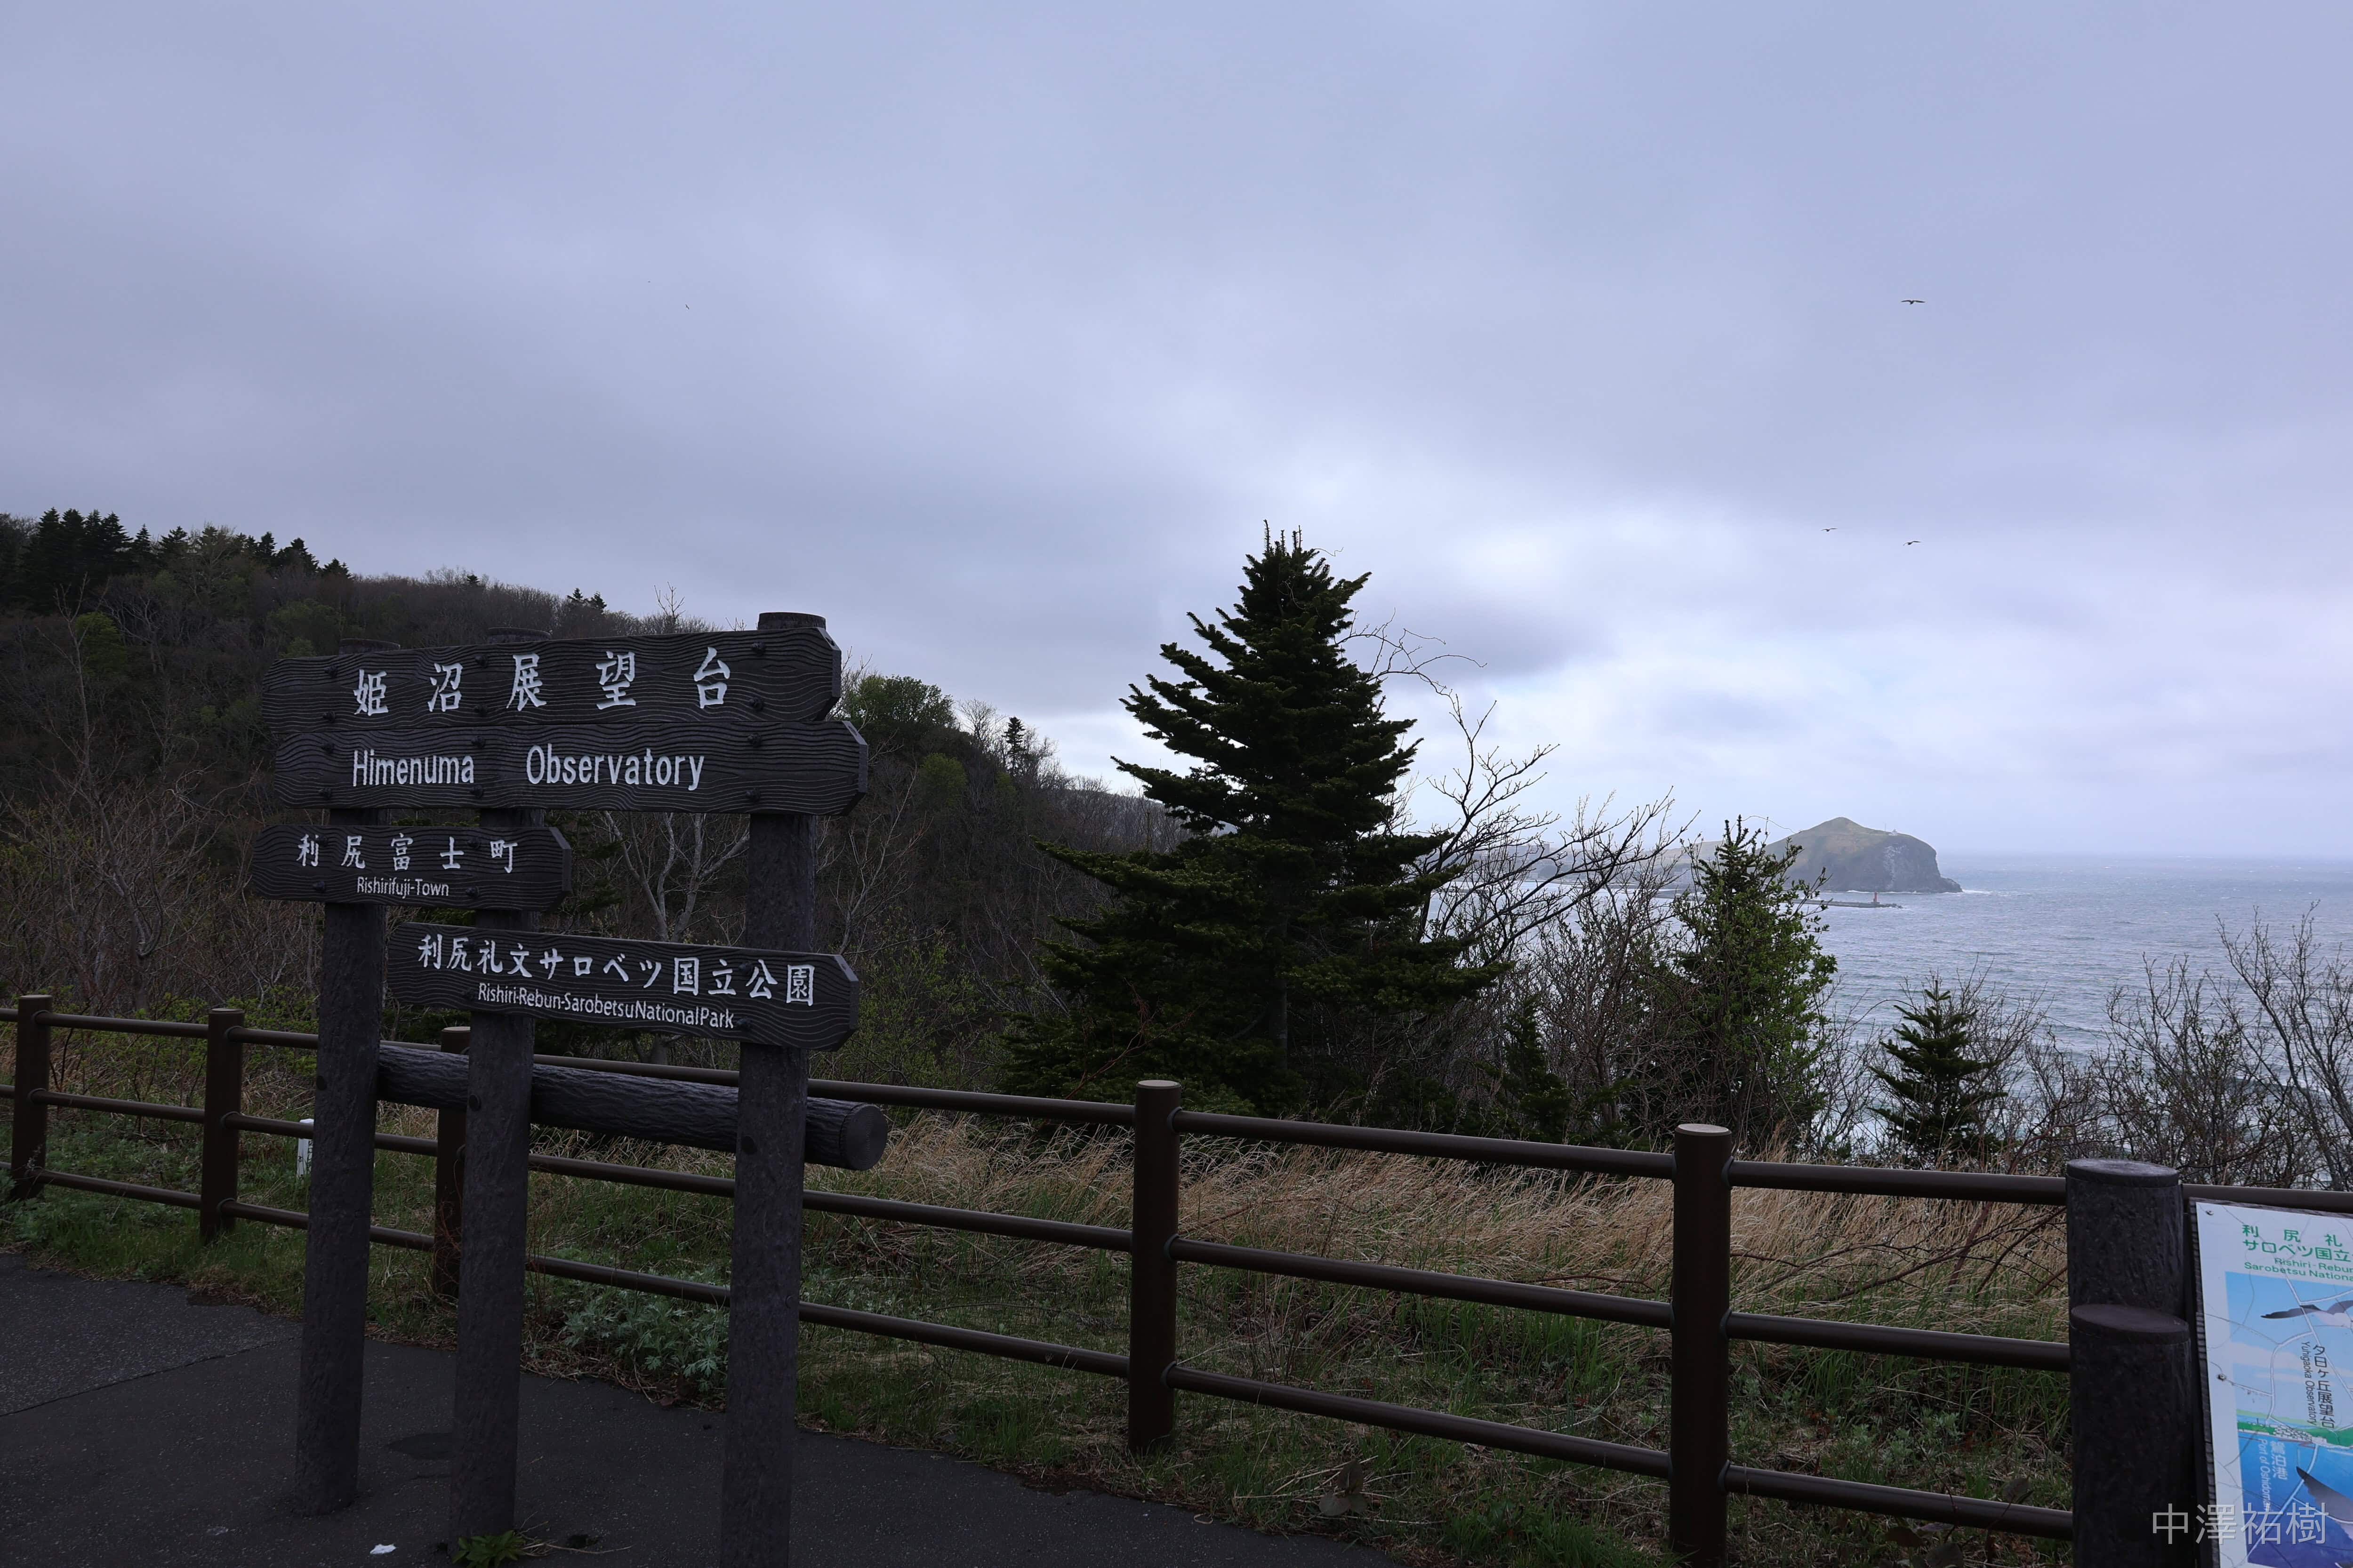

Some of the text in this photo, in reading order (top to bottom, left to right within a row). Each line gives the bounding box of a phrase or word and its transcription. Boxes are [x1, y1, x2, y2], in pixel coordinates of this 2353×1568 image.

[353, 646, 731, 716] 姫沼展望台
[352, 743, 705, 791] Himenuma Observatory
[296, 832, 518, 873] 利尻富士町
[357, 876, 449, 899] Rishirifuji-Town
[418, 933, 815, 1007] 利尻礼文サロベツ国立公園
[2242, 1240, 2353, 1262] サロベツ国立
[2244, 1262, 2306, 1276] Sarobetsu
[2300, 1341, 2317, 1425] Yuhigaoka Observatory
